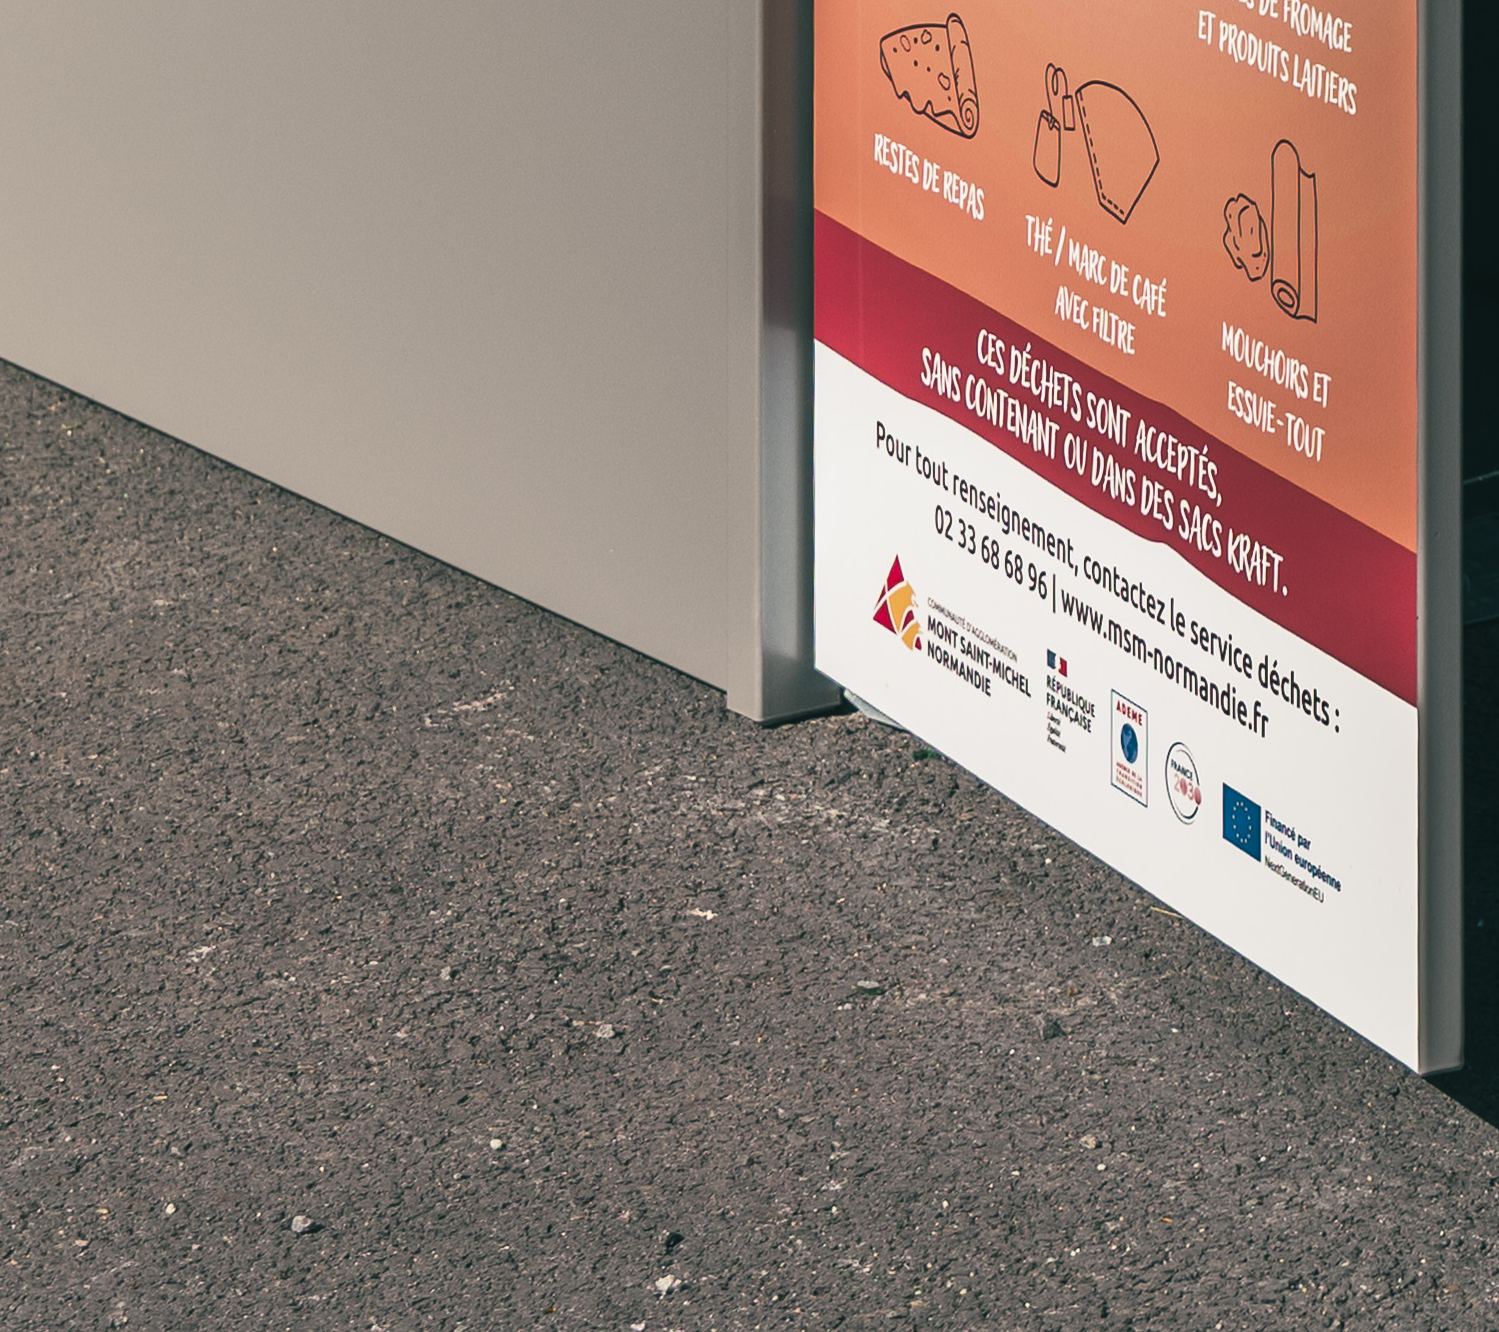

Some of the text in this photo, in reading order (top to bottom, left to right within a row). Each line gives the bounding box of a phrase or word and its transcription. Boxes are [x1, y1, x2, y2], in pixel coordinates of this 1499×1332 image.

[1198, 10, 1358, 116] ET PRODUITS LAITIERS
[874, 133, 985, 221] RESTES DE REPAS
[1025, 214, 1053, 257] THÉ
[1068, 238, 1108, 286] MARC
[1109, 260, 1130, 297] DE
[1132, 273, 1168, 318] CAFÉ
[1054, 285, 1136, 356] AVEC FILTRE
[1221, 321, 1332, 409] MOUCHOIRS ET
[977, 328, 1223, 508] CES DÉCHETS SONT ACCEPTÉS,
[1227, 380, 1326, 463] ESSUIE-TOUT
[920, 347, 1288, 597] SANS CONTENANT OU DANS DES SACS KRAFT.
[876, 420, 912, 467] Pour
[915, 445, 949, 491] tout
[953, 474, 1079, 577] renseignement,
[1083, 556, 1166, 626] contactez
[1170, 597, 1186, 638] le
[1190, 620, 1253, 679] service
[1257, 655, 1331, 727] déchets
[927, 615, 1032, 698] MONT SAINT-MICHEL
[935, 504, 953, 541] 02
[958, 518, 976, 555] 33
[981, 535, 1000, 570] 68
[1004, 550, 1023, 585] 68
[1028, 562, 1048, 600] 96
[1060, 589, 1269, 738] www.msm-normandie.fr
[927, 639, 992, 697] NORMANDIE
[1046, 674, 1096, 718] RÉPUBLIQUE
[1046, 692, 1092, 733] FRANÇAISE
[1116, 700, 1143, 726] ADEME
[1171, 758, 1193, 781] FRANCE
[1174, 773, 1202, 806] 2030
[1265, 810, 1311, 851] Financé par
[1265, 830, 1342, 892] l'Union européenne
[1264, 855, 1325, 904] NextGenerationEU
